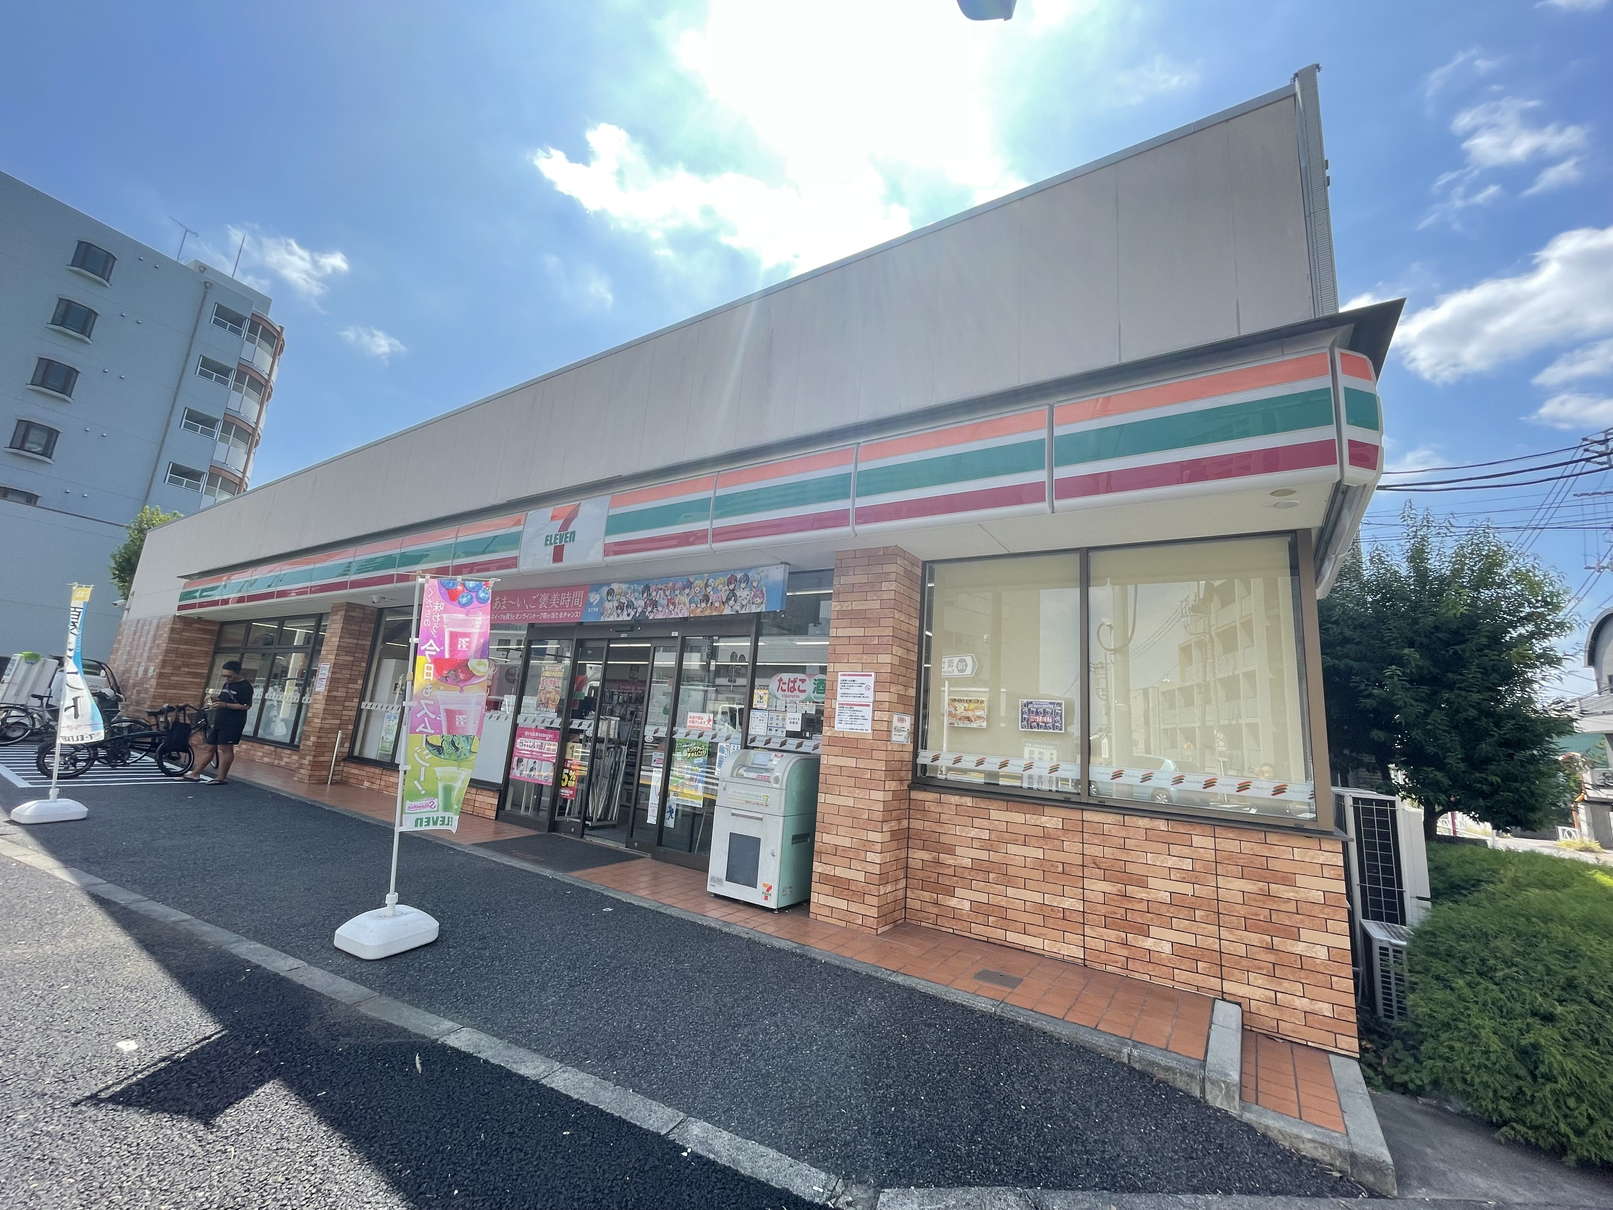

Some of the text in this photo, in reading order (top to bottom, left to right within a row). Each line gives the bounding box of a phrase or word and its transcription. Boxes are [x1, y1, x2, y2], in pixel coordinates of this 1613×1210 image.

[551, 502, 581, 564] 7
[776, 677, 806, 694] たばこ
